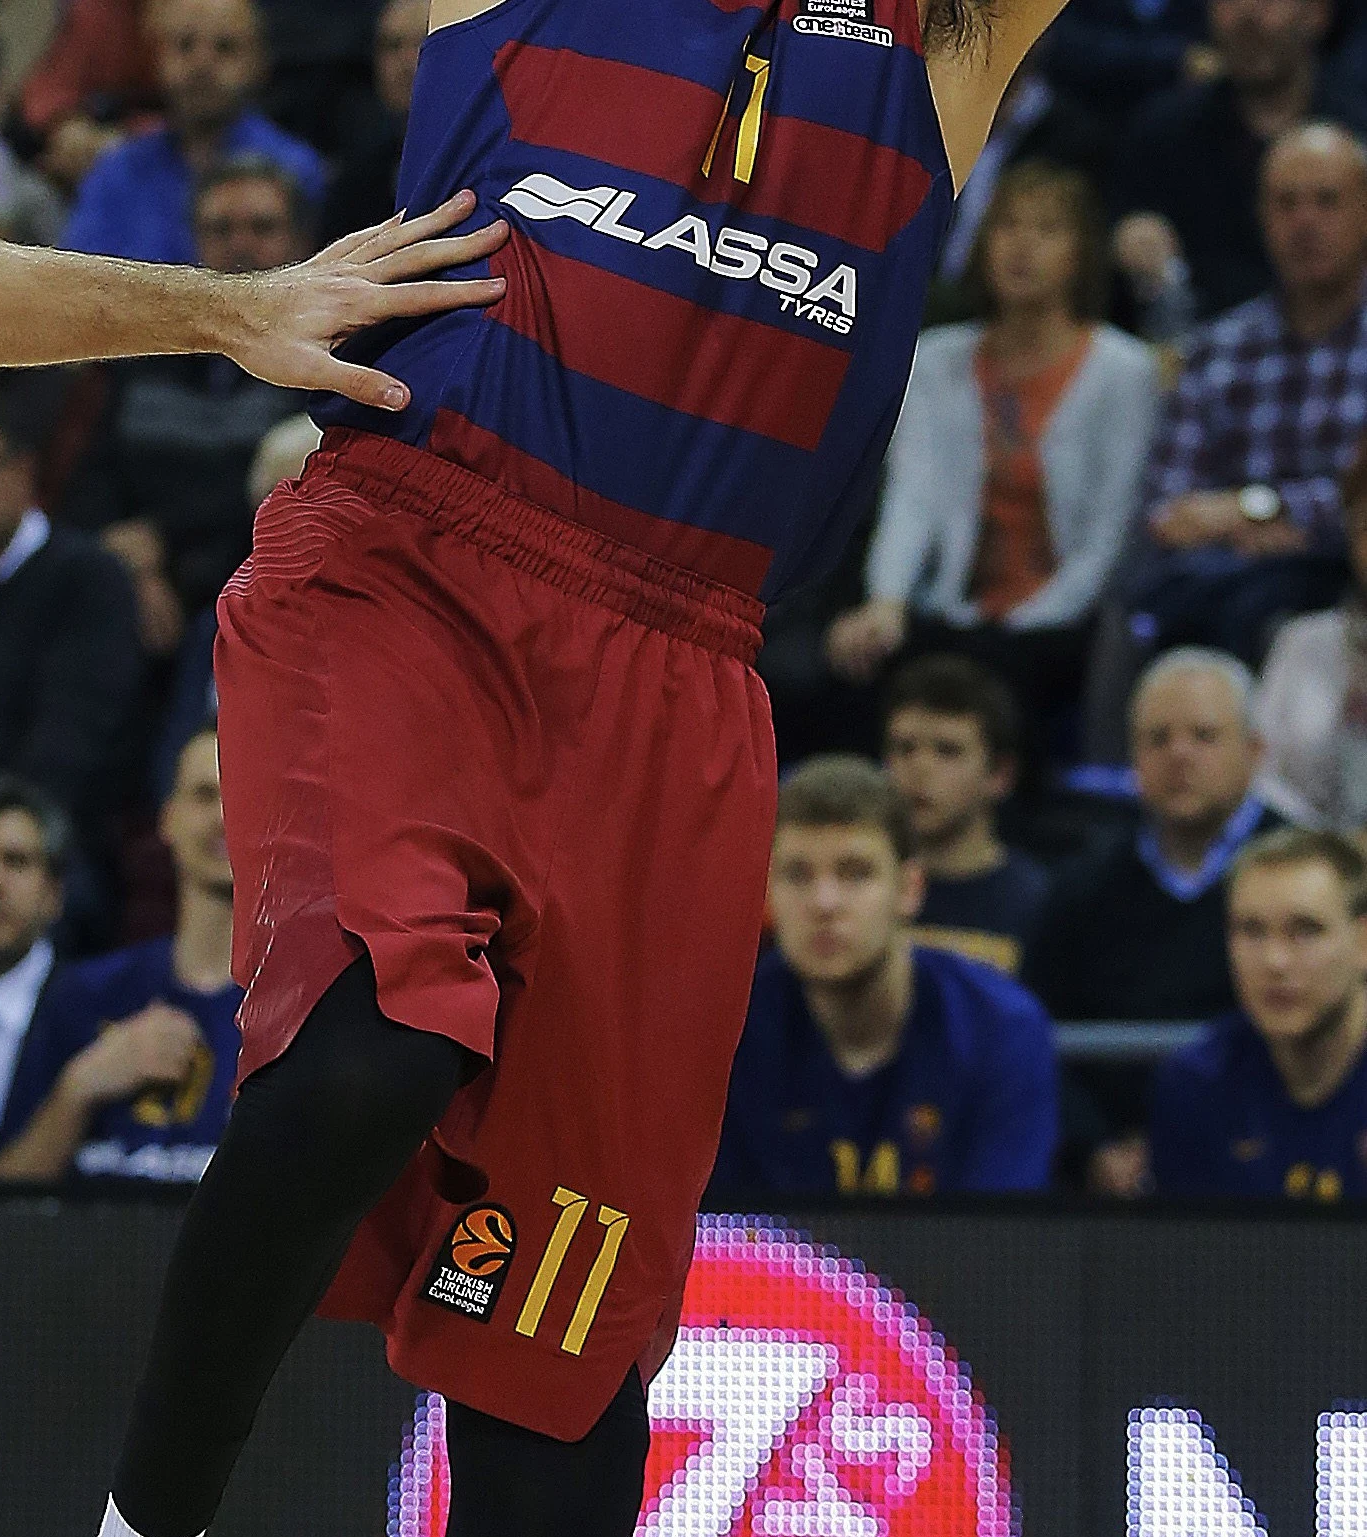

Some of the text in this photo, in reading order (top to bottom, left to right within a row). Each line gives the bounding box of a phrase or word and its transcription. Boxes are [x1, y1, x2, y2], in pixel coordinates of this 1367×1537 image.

[592, 191, 857, 318] LASSA
[779, 293, 854, 334] TYRES
[433, 1277, 490, 1305] AIRLINES
[440, 1266, 494, 1295] TURKISH
[514, 1185, 630, 1357] 11
